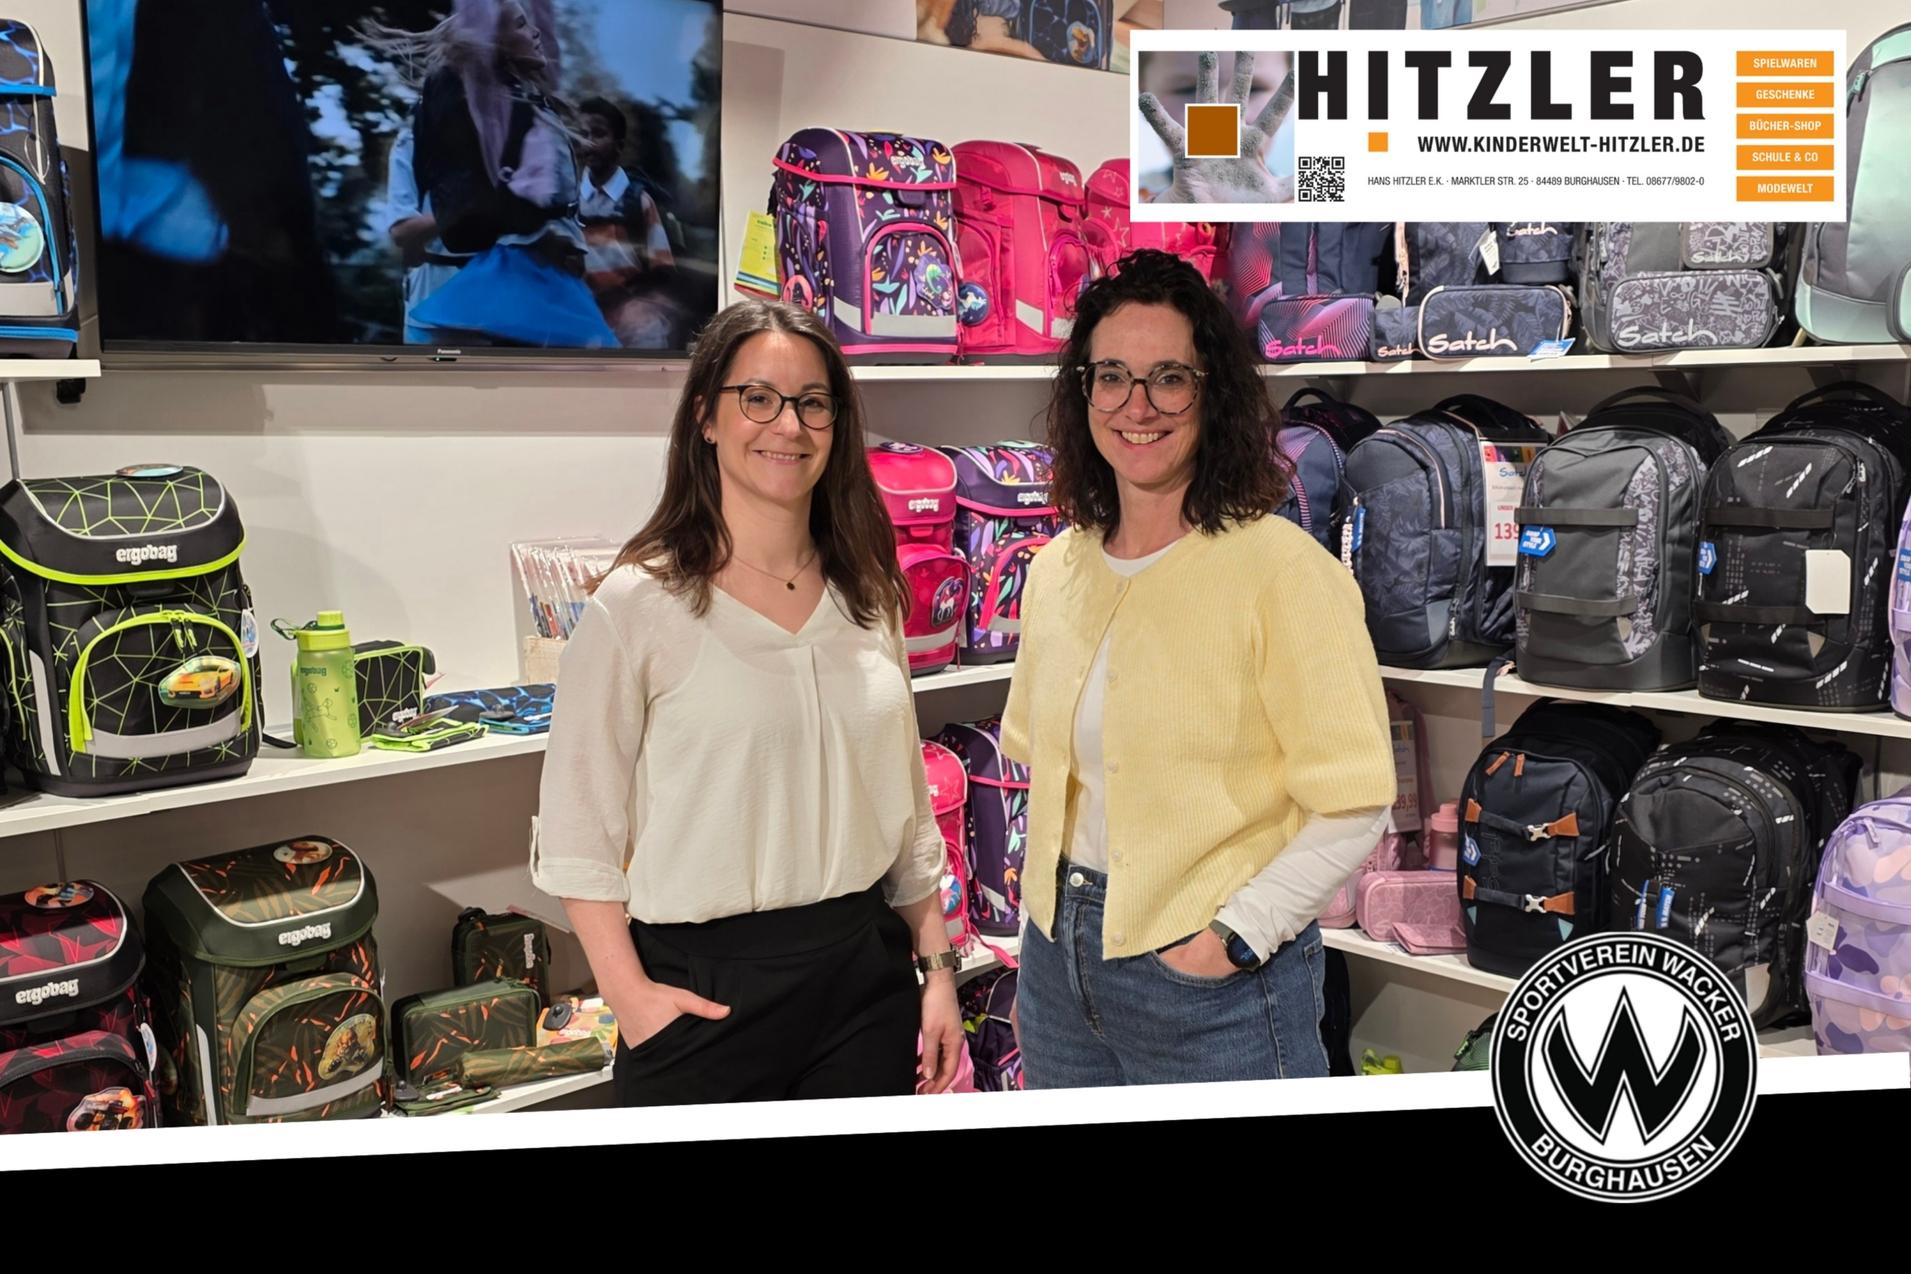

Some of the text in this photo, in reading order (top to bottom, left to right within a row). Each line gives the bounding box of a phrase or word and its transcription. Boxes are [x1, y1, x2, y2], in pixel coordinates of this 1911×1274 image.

[1427, 328, 1518, 354] Satch
[1616, 318, 1718, 347] Satch
[1264, 335, 1341, 359] Satch
[1377, 342, 1422, 358] Satch
[115, 544, 178, 566] ergobag
[278, 921, 332, 947] ergobag
[15, 978, 80, 1006] ergobag
